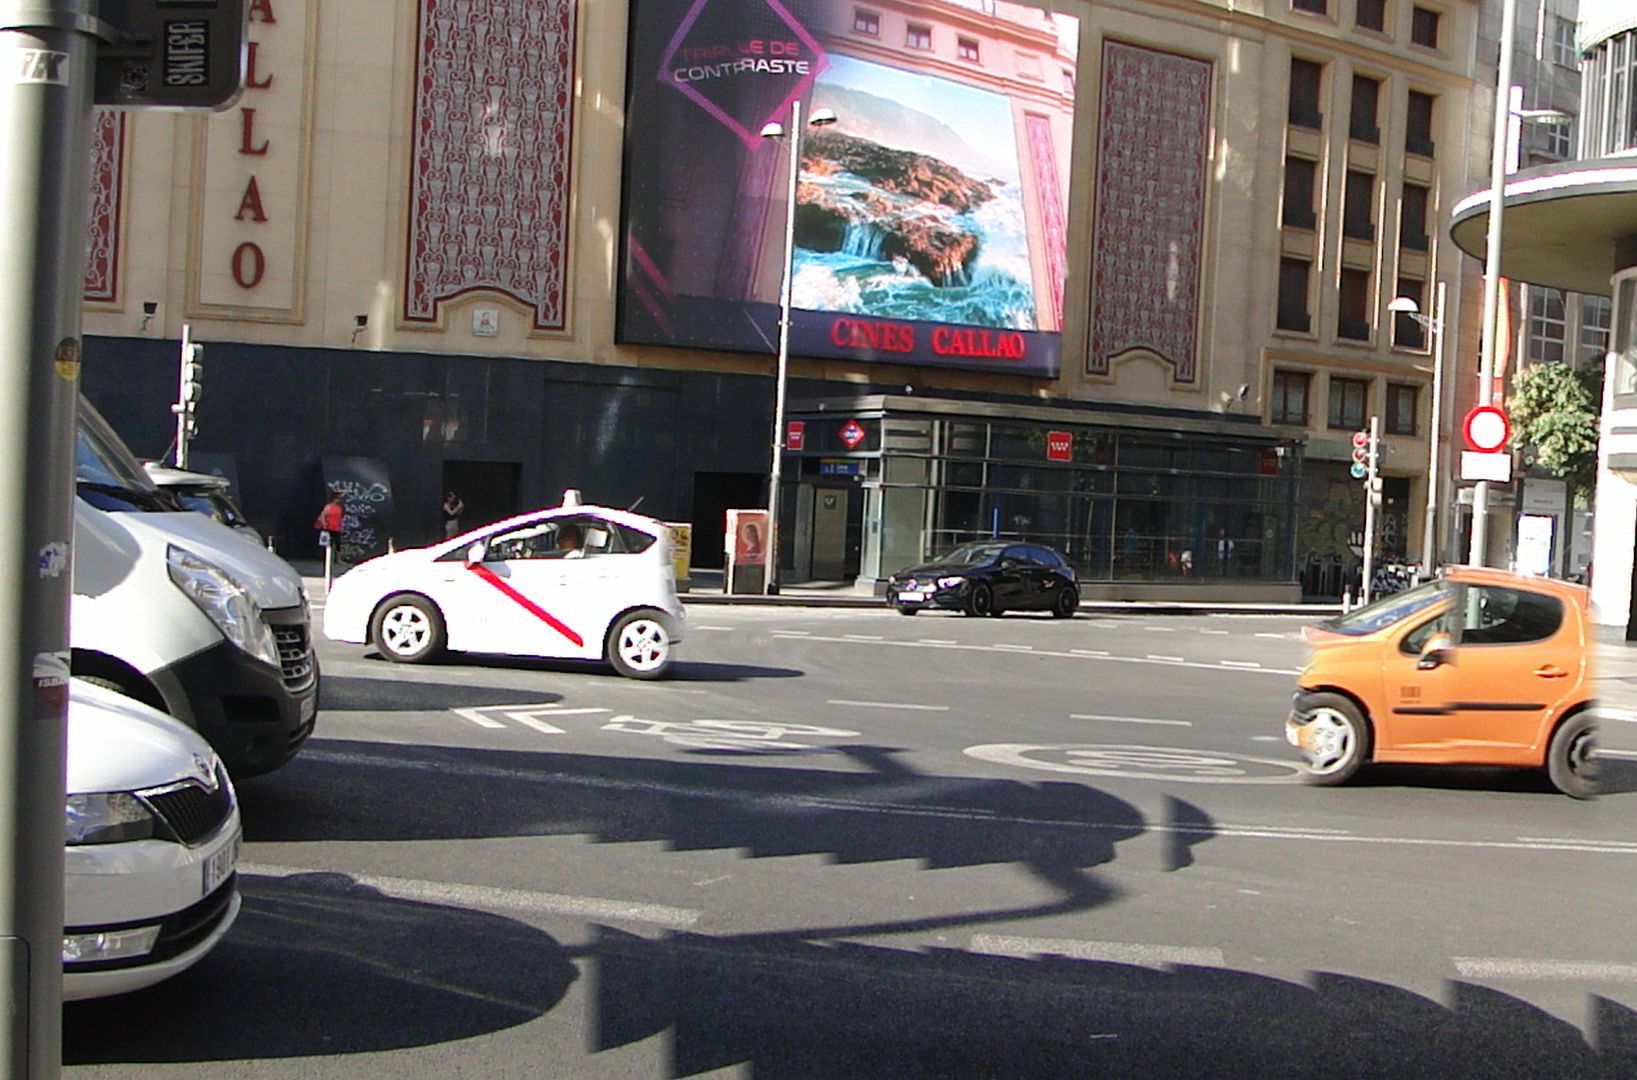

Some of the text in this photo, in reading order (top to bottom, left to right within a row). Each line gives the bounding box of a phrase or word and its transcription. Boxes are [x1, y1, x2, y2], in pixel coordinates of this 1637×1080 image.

[770, 40, 799, 56] DE
[831, 318, 1026, 359] CINES CALLAO
